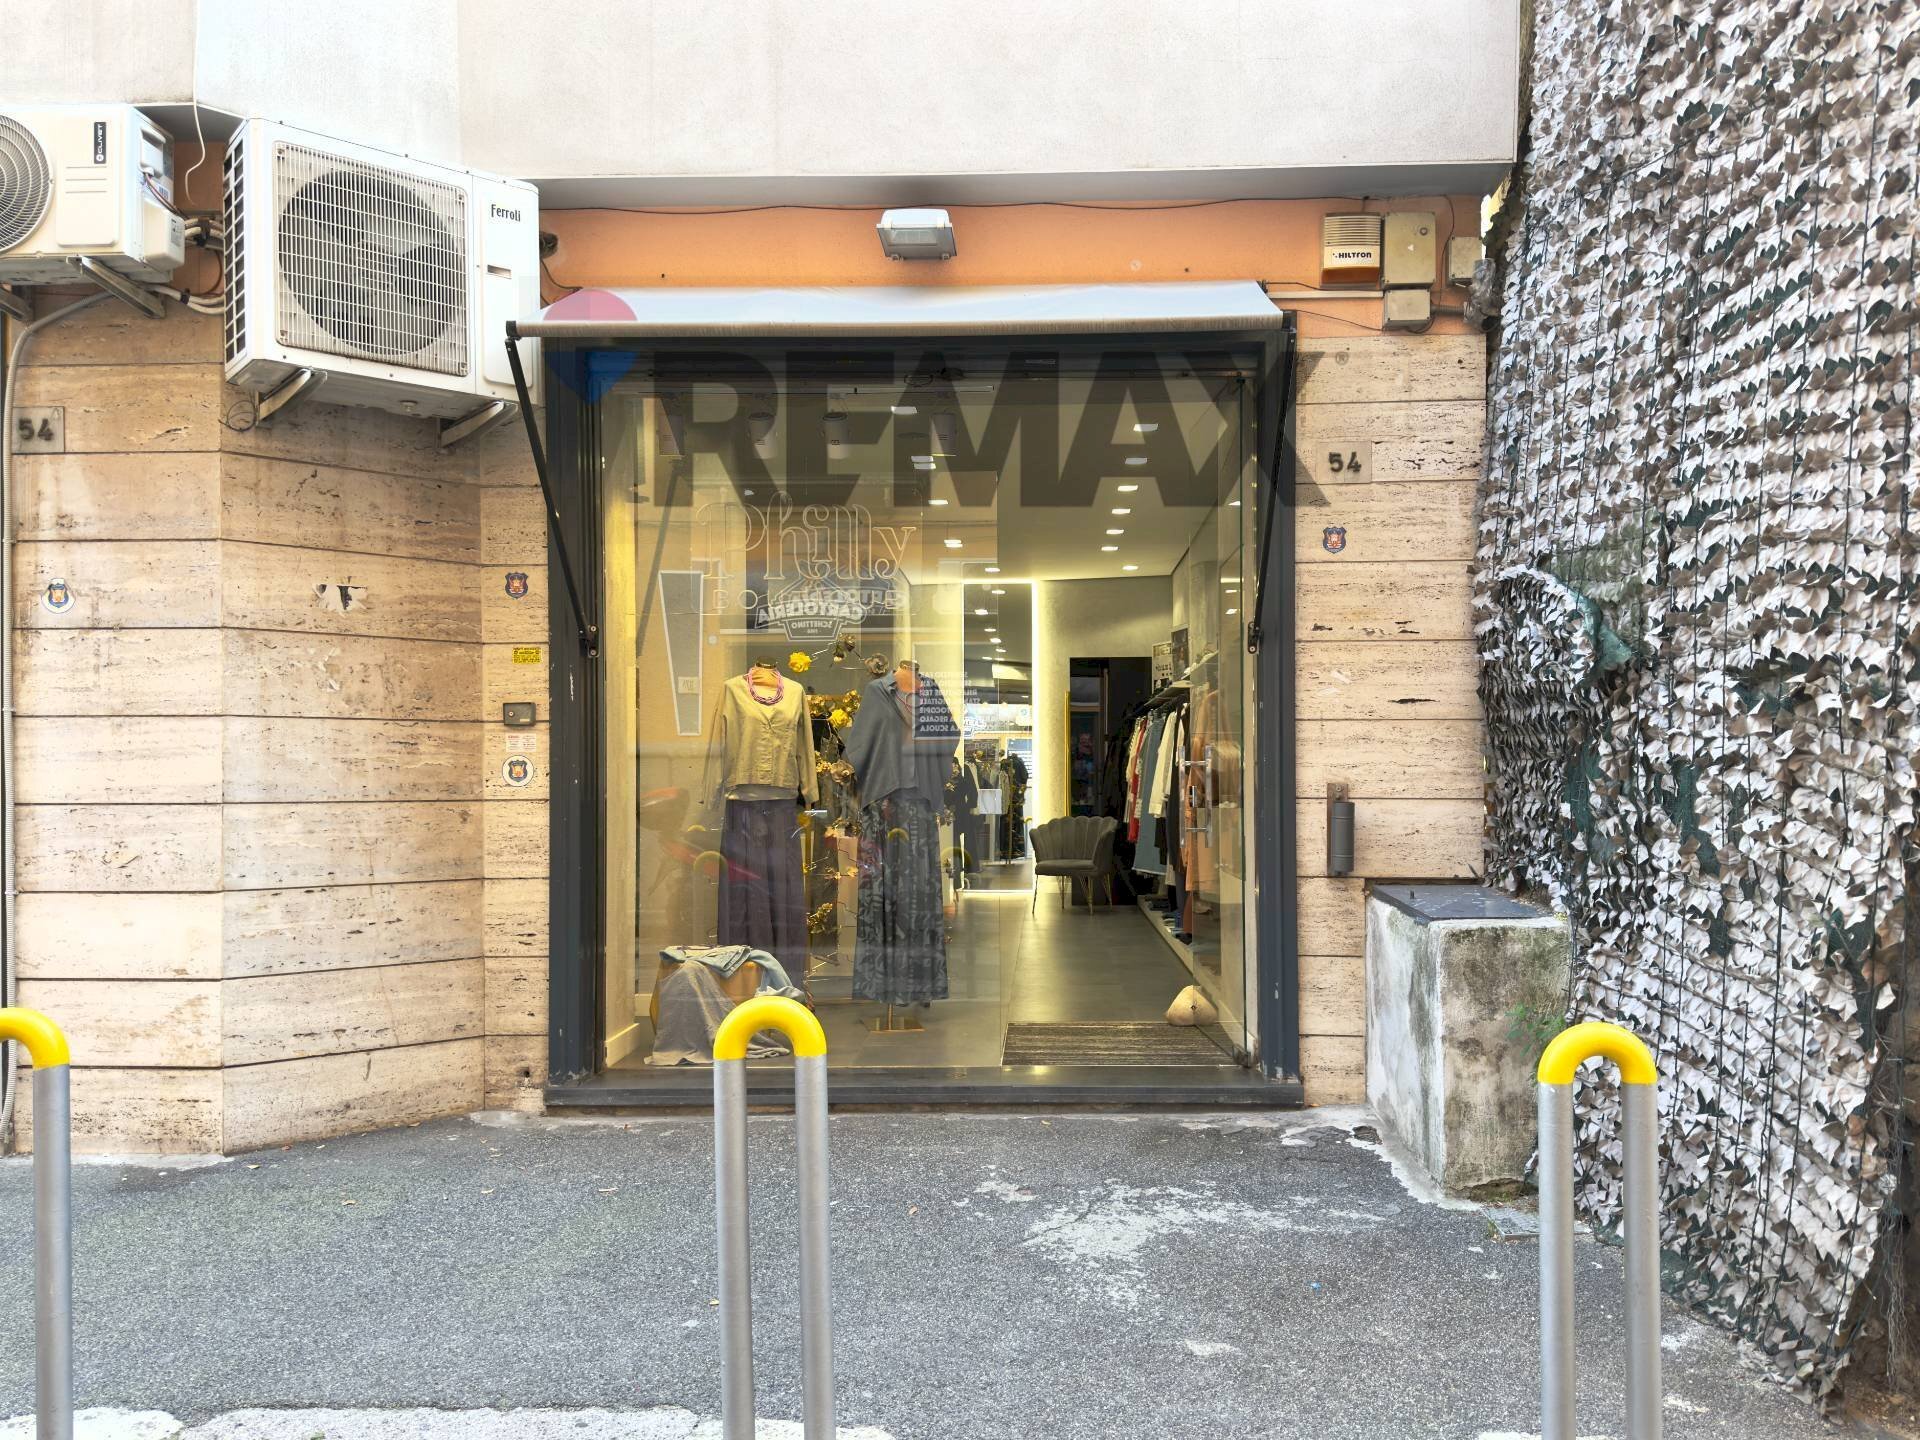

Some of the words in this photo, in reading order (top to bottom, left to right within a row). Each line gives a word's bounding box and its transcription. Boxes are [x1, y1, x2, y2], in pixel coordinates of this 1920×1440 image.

[491, 203, 521, 222] Ferroli
[18, 418, 55, 442] 54
[1327, 451, 1363, 473] 54
[695, 490, 918, 580] Philly
